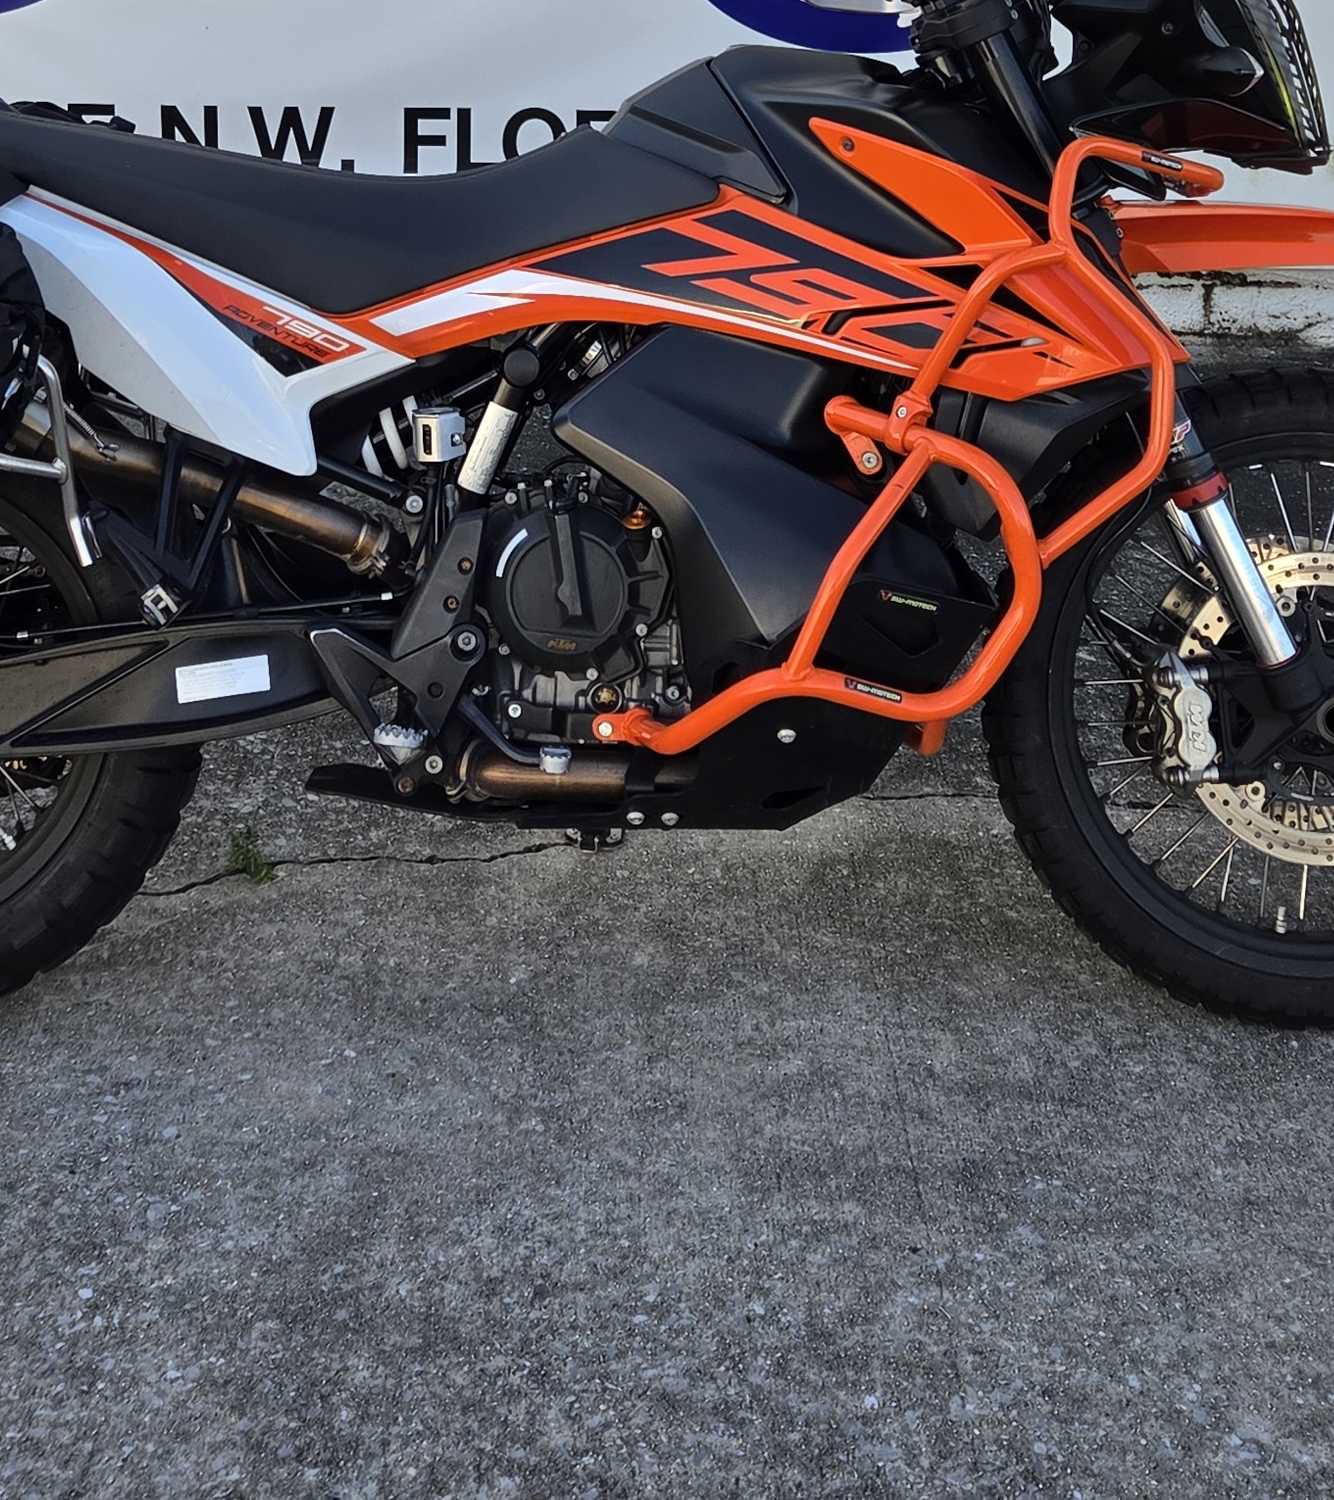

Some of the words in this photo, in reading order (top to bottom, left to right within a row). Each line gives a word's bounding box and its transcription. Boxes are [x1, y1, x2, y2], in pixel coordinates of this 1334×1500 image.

[222, 304, 331, 359] ADVENTURE
[262, 305, 350, 353] 790
[1186, 703, 1207, 753] KTM
